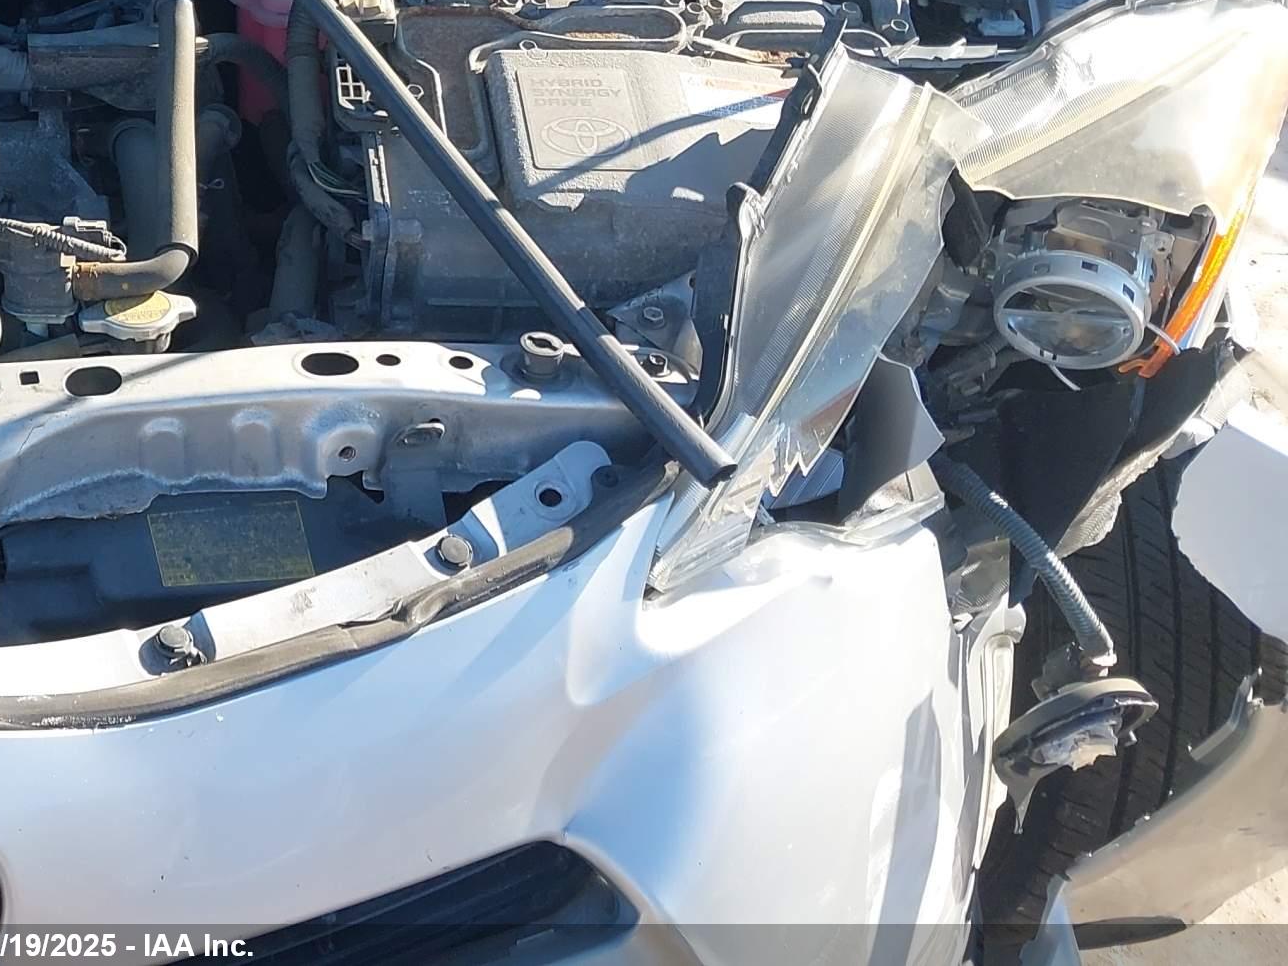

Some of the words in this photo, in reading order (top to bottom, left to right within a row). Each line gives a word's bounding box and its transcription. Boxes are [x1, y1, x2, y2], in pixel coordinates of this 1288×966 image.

[530, 79, 602, 88] HYBRID
[534, 89, 621, 97] SYNERGY
[534, 98, 592, 106] DRIVE
